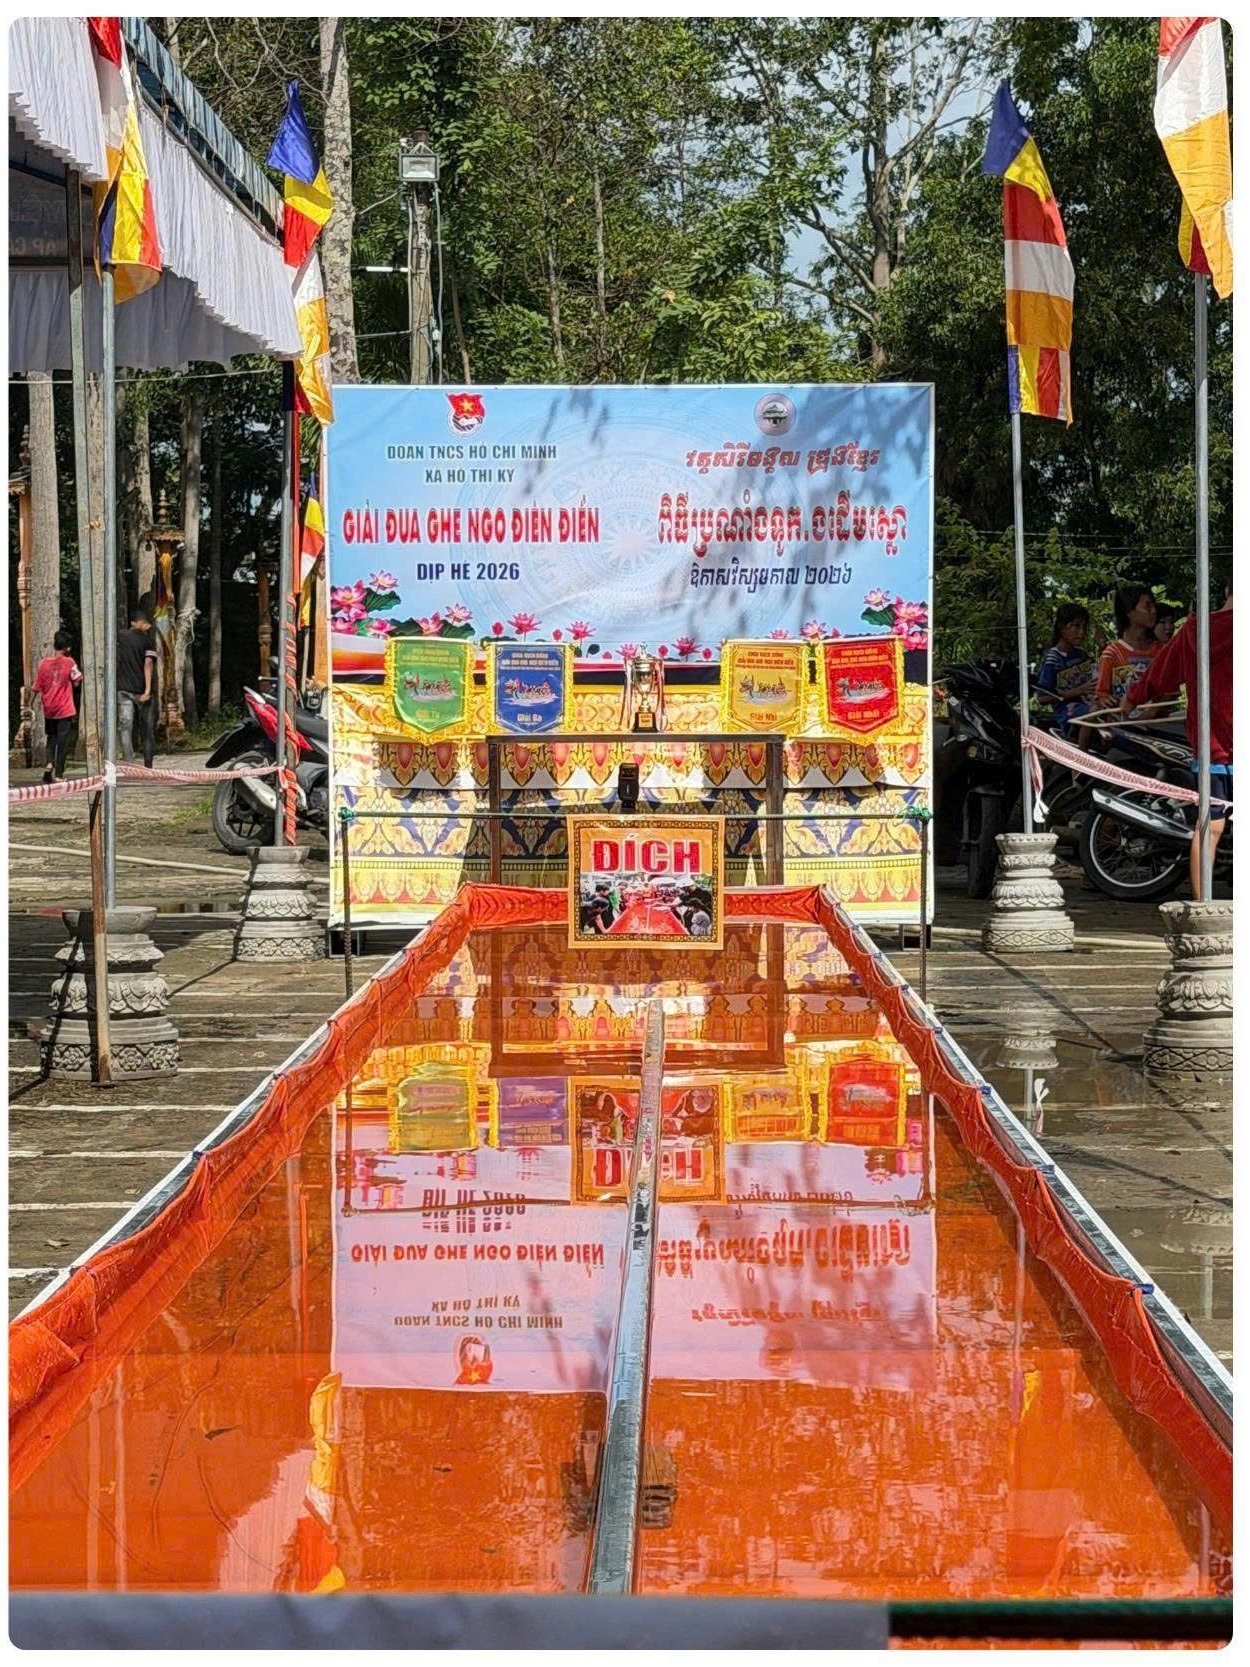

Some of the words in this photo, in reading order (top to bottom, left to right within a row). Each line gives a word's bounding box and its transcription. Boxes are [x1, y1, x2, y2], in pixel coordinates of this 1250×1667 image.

[430, 444, 464, 460] TNCS
[521, 445, 557, 460] MINH
[342, 499, 379, 544] GIẢI
[385, 507, 421, 544] ĐUA
[426, 507, 461, 544] GHE
[467, 507, 506, 544] NGO
[416, 562, 445, 584] DỊP
[477, 562, 520, 580] 2026
[592, 832, 702, 874] ĐÍCH
